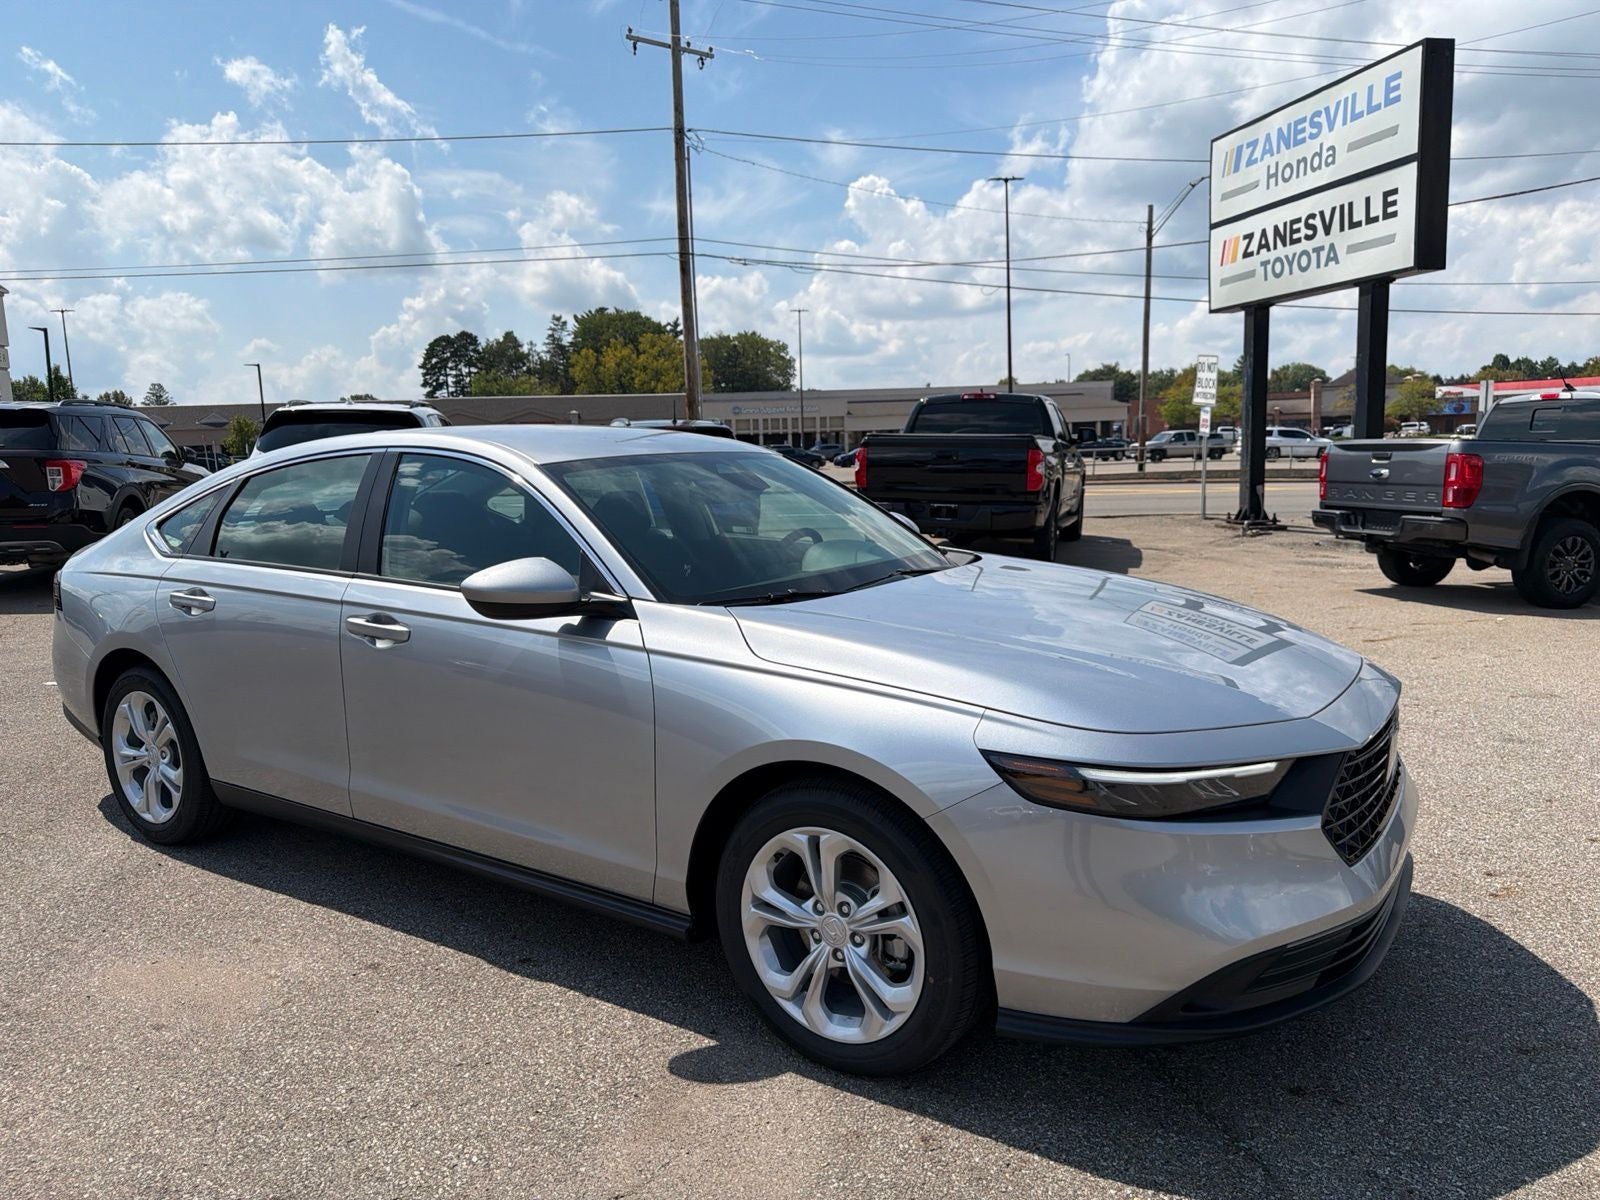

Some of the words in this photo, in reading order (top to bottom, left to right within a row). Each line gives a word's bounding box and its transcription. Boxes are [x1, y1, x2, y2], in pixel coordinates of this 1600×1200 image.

[1245, 70, 1403, 169] ZANESVILLE
[1266, 142, 1337, 190] Honda
[1242, 187, 1399, 260] ZANESVILLE
[1260, 242, 1340, 282] TOYOTA
[1197, 377, 1216, 389] BLOCK
[1198, 362, 1206, 373] DO
[1207, 362, 1217, 374] NOT
[1328, 488, 1439, 503] RANGER
